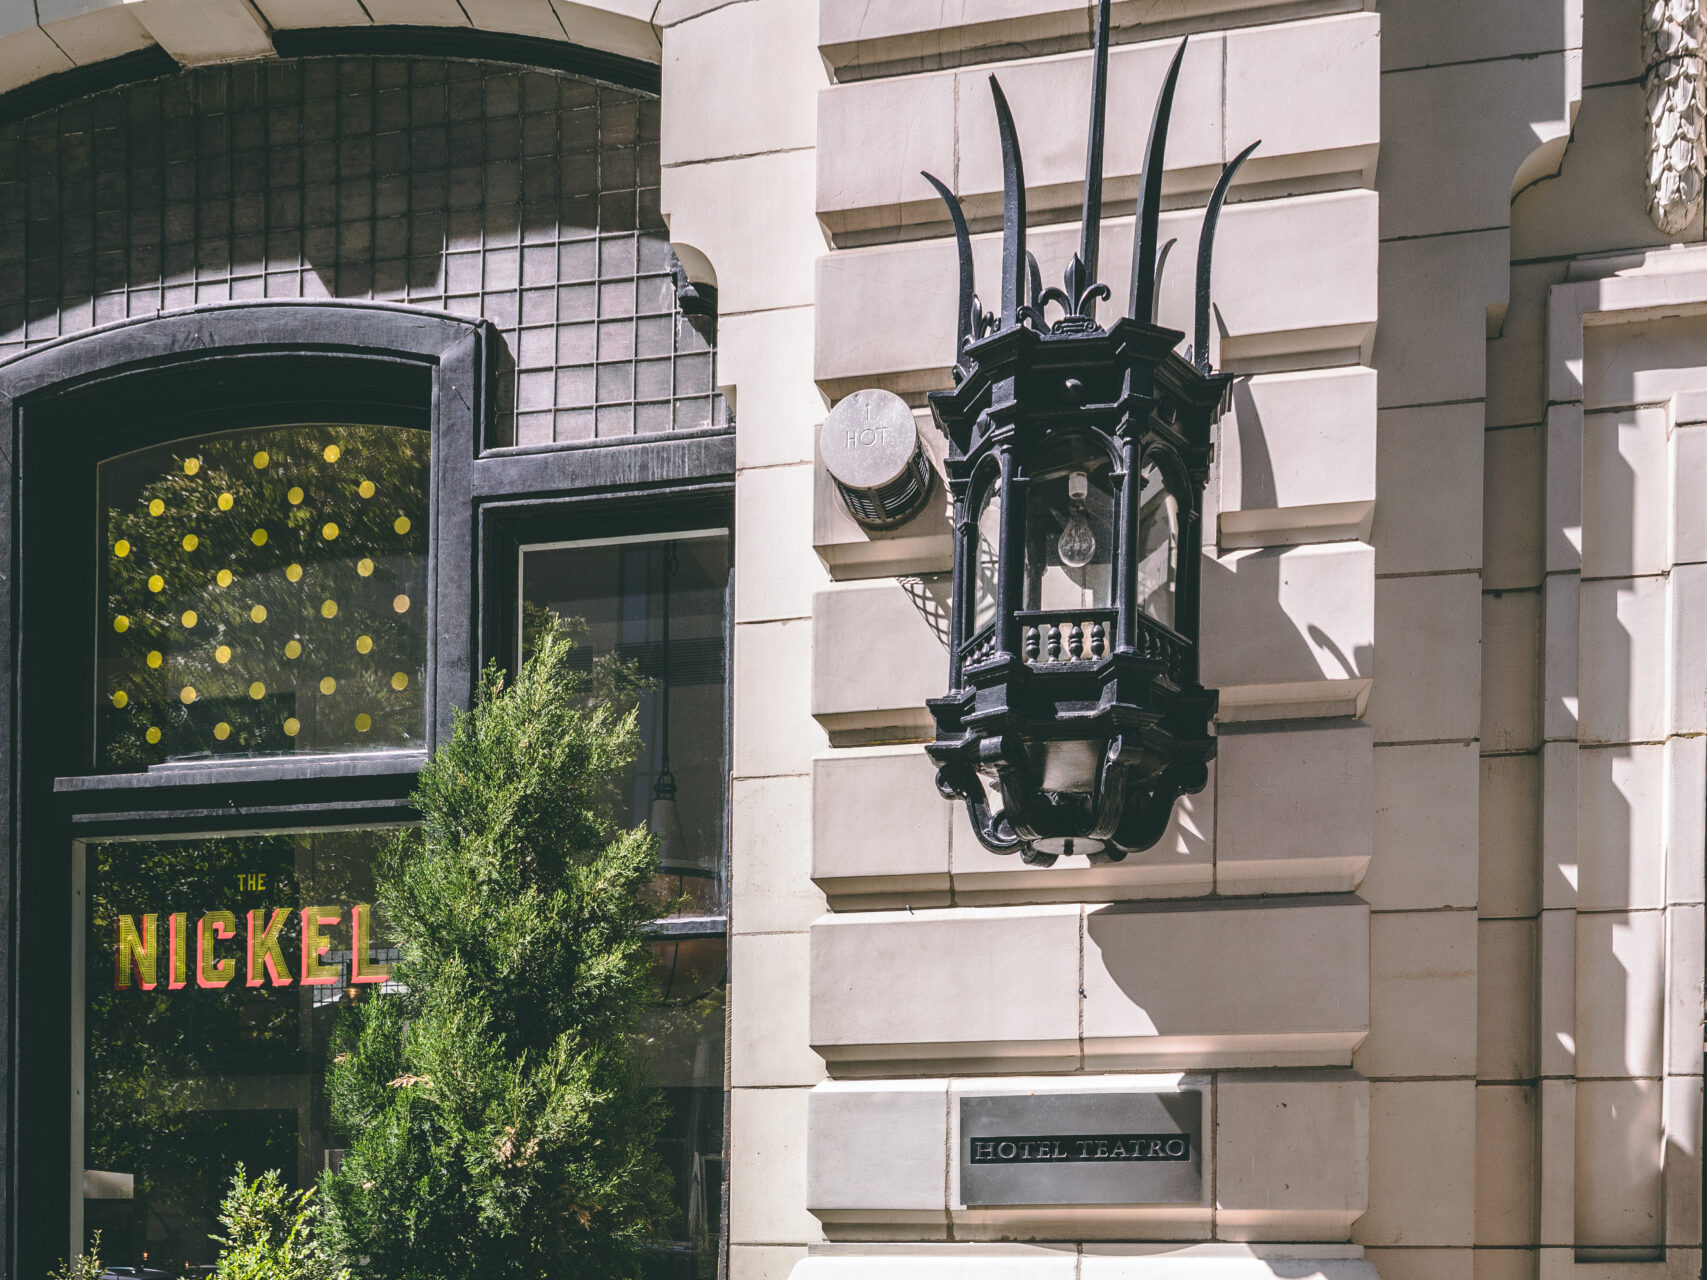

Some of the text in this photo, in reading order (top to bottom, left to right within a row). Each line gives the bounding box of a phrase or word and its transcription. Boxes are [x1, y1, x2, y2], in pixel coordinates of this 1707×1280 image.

[846, 426, 889, 449] HOT
[237, 873, 266, 891] THE
[114, 904, 391, 990] NICKEL
[975, 1139, 1185, 1159] HOTEL TEATRO
